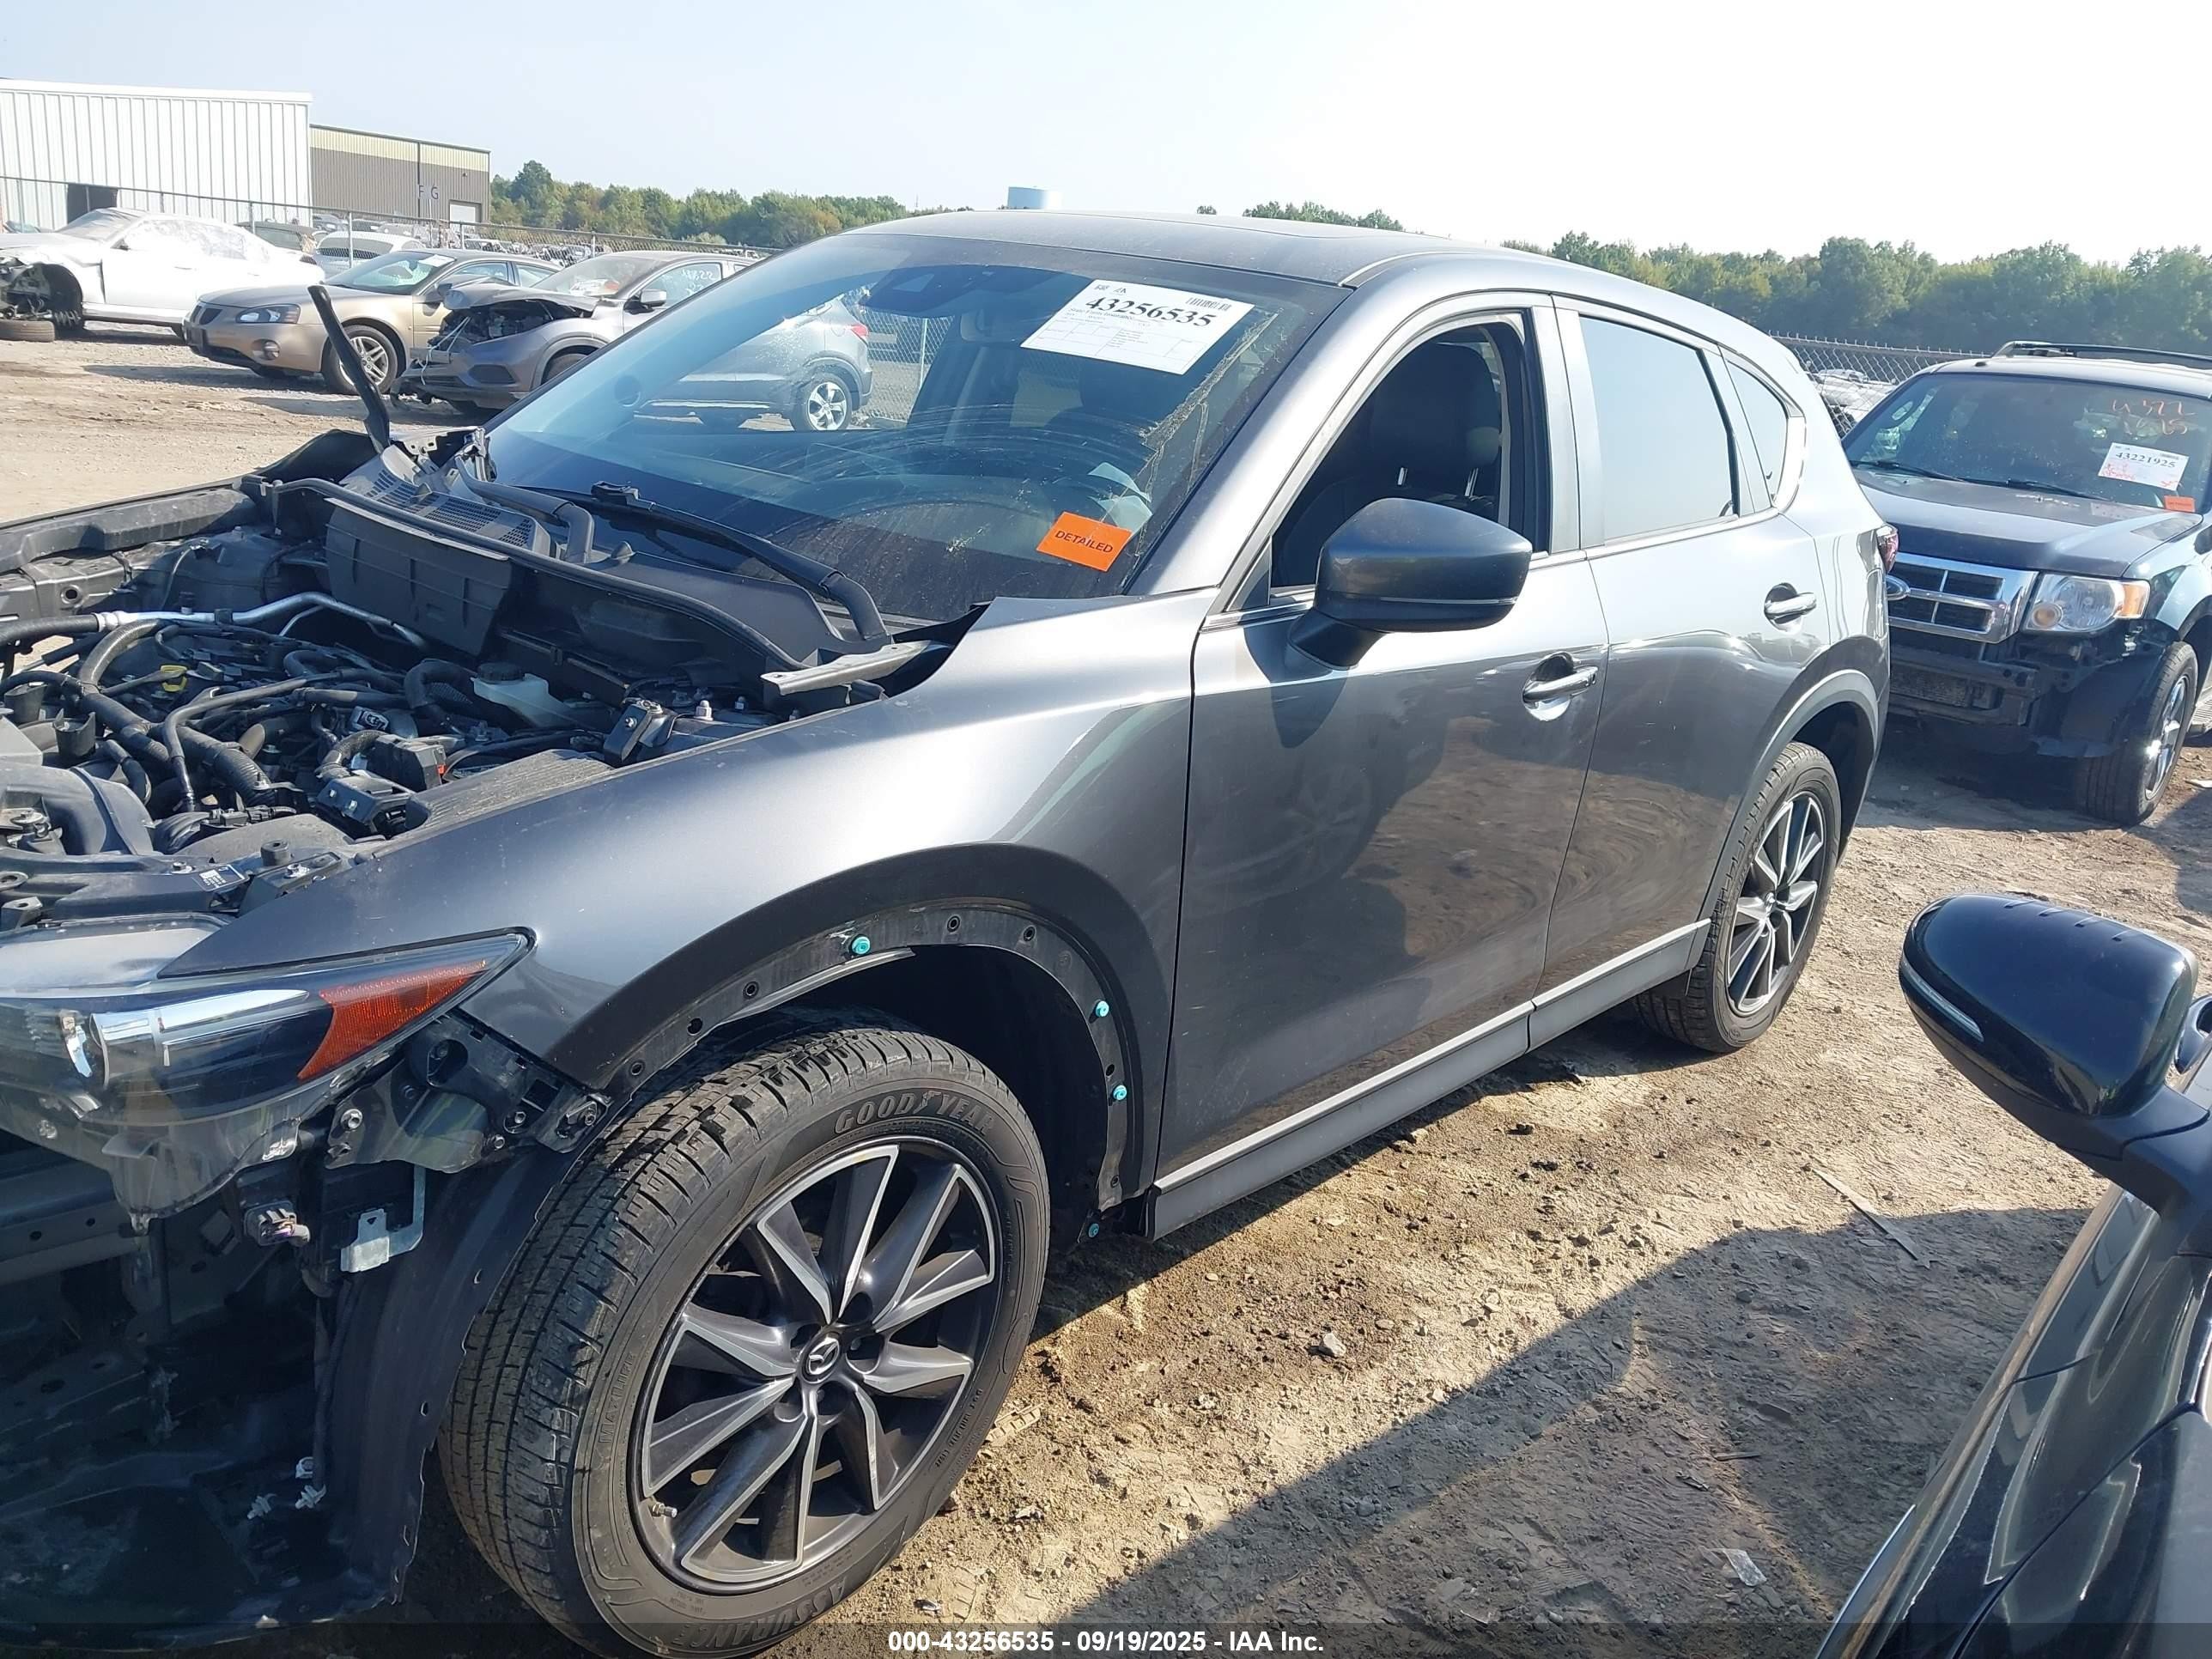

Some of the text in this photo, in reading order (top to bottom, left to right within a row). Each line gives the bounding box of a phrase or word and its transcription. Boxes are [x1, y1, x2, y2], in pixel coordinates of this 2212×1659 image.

[418, 185, 439, 200] F G
[1085, 297, 1217, 326] 43256535
[2115, 452, 2177, 468] 43221925
[1054, 530, 1114, 553] DETAILED
